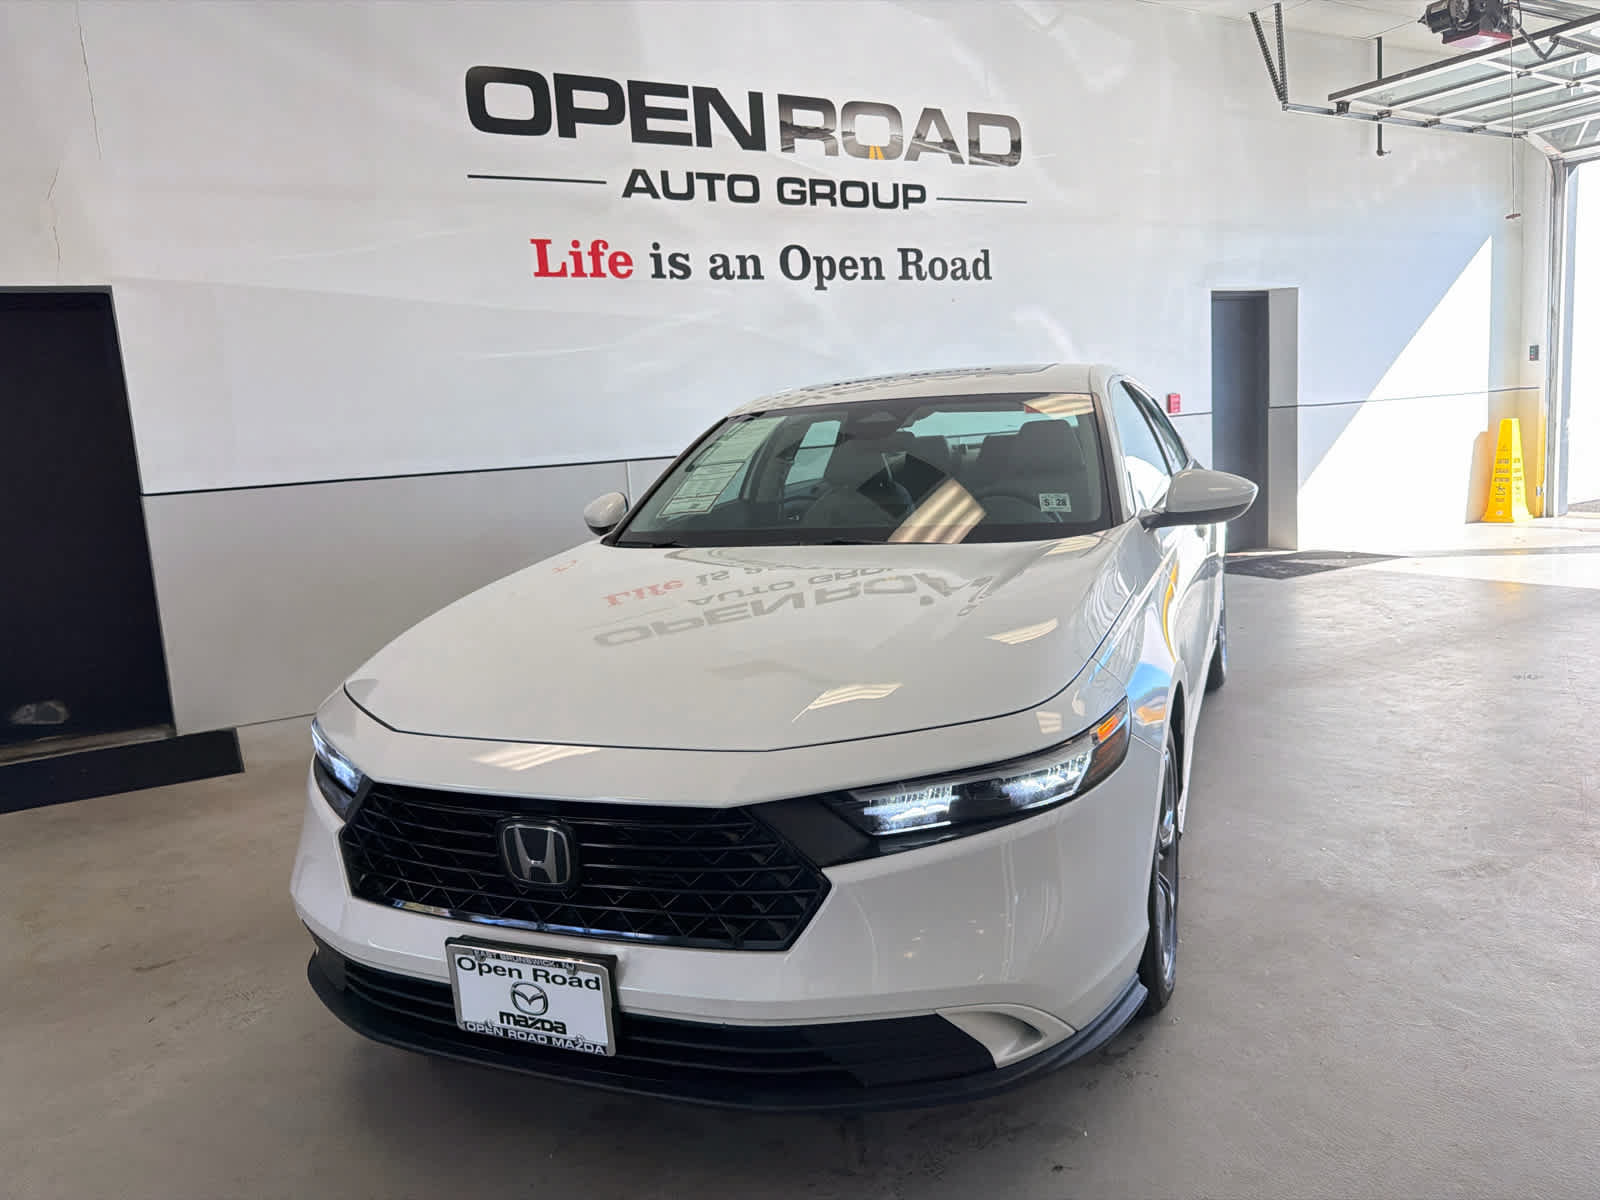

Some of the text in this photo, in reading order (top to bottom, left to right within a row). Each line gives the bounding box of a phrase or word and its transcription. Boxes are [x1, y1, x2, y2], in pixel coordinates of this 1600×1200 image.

[465, 65, 1023, 167] OPEN ROAD
[622, 168, 927, 210] AUTO GROUP
[530, 238, 993, 290] Life is an Open Road
[457, 957, 601, 991] Open Road
[467, 1022, 607, 1055] OPEN ROAD MAZDA
